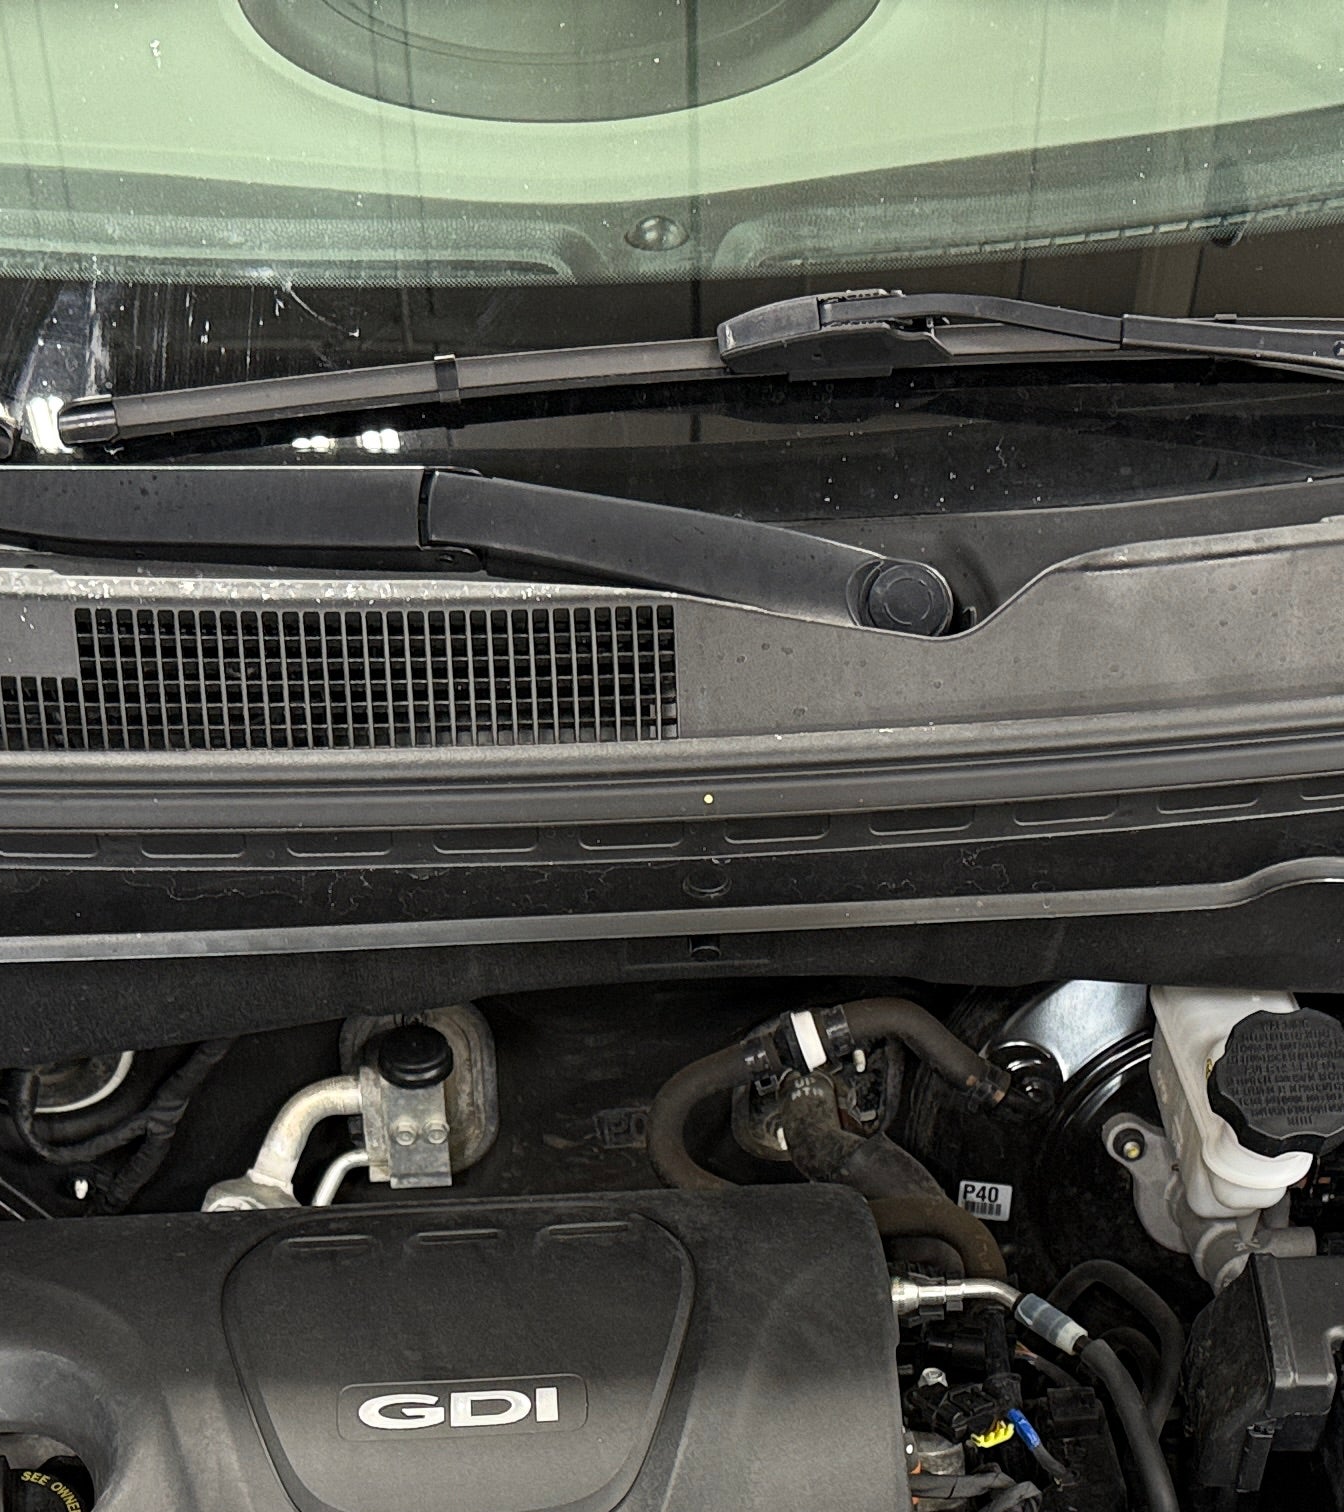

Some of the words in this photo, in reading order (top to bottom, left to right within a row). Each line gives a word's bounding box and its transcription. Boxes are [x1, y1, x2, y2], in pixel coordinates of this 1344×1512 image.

[963, 1184, 999, 1202] P40
[358, 1385, 559, 1430] GDI
[21, 1471, 51, 1486] SEE
